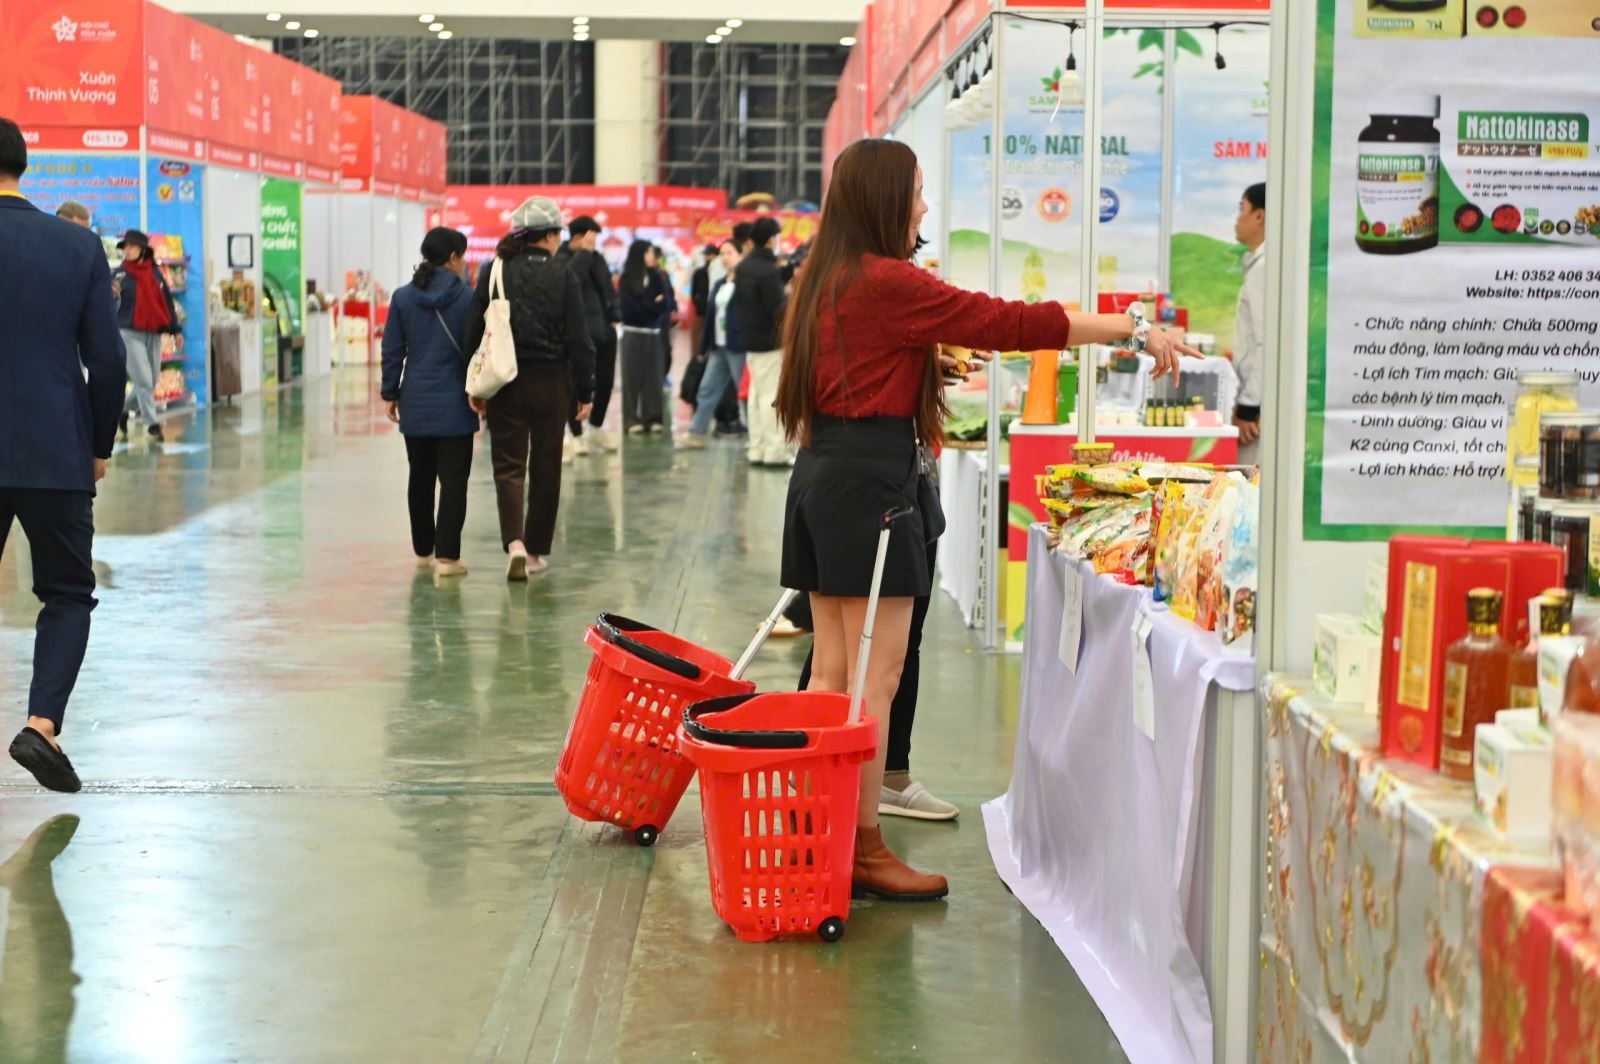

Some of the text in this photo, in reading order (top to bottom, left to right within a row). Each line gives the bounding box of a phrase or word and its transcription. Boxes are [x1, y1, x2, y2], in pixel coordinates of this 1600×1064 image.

[79, 70, 116, 85] Xuân
[27, 87, 116, 105] Thịnh Vượng
[1466, 114, 1580, 141] Nattokinase
[983, 134, 1130, 156] 10% NATRAL
[1494, 269, 1519, 282] LH:
[1521, 269, 1556, 283] 0352
[1465, 285, 1525, 299] Website:
[1364, 316, 1405, 331] Chức
[1409, 317, 1447, 335] năng
[1451, 317, 1497, 332] chính:
[1502, 317, 1542, 333] Chứa
[1546, 318, 1599, 336] 500mg
[1352, 341, 1387, 356] máu
[1388, 341, 1429, 359] đông,
[1432, 341, 1461, 356] làm
[1462, 341, 1505, 359] loãng
[1506, 342, 1540, 357] máu
[1542, 342, 1561, 357] và
[1361, 366, 1386, 383] Lợi
[1387, 365, 1410, 381] ích
[1414, 366, 1441, 380] Tim
[1443, 366, 1489, 383] mạch:
[1493, 367, 1519, 383] Giú
[1351, 390, 1506, 409] các bệnh lý tim mạch.
[1359, 415, 1395, 429] Dinh
[1397, 415, 1448, 433] dưỡng:
[1451, 415, 1488, 430] Giàu
[1490, 415, 1503, 430] vi
[1349, 436, 1507, 455] K2 cùng Canxi, tốt ch
[1357, 462, 1381, 479] Lợi
[1383, 463, 1406, 477] ích
[1408, 463, 1450, 477] khác:
[1452, 460, 1475, 478] Hỗ
[1477, 464, 1501, 481] trợ
